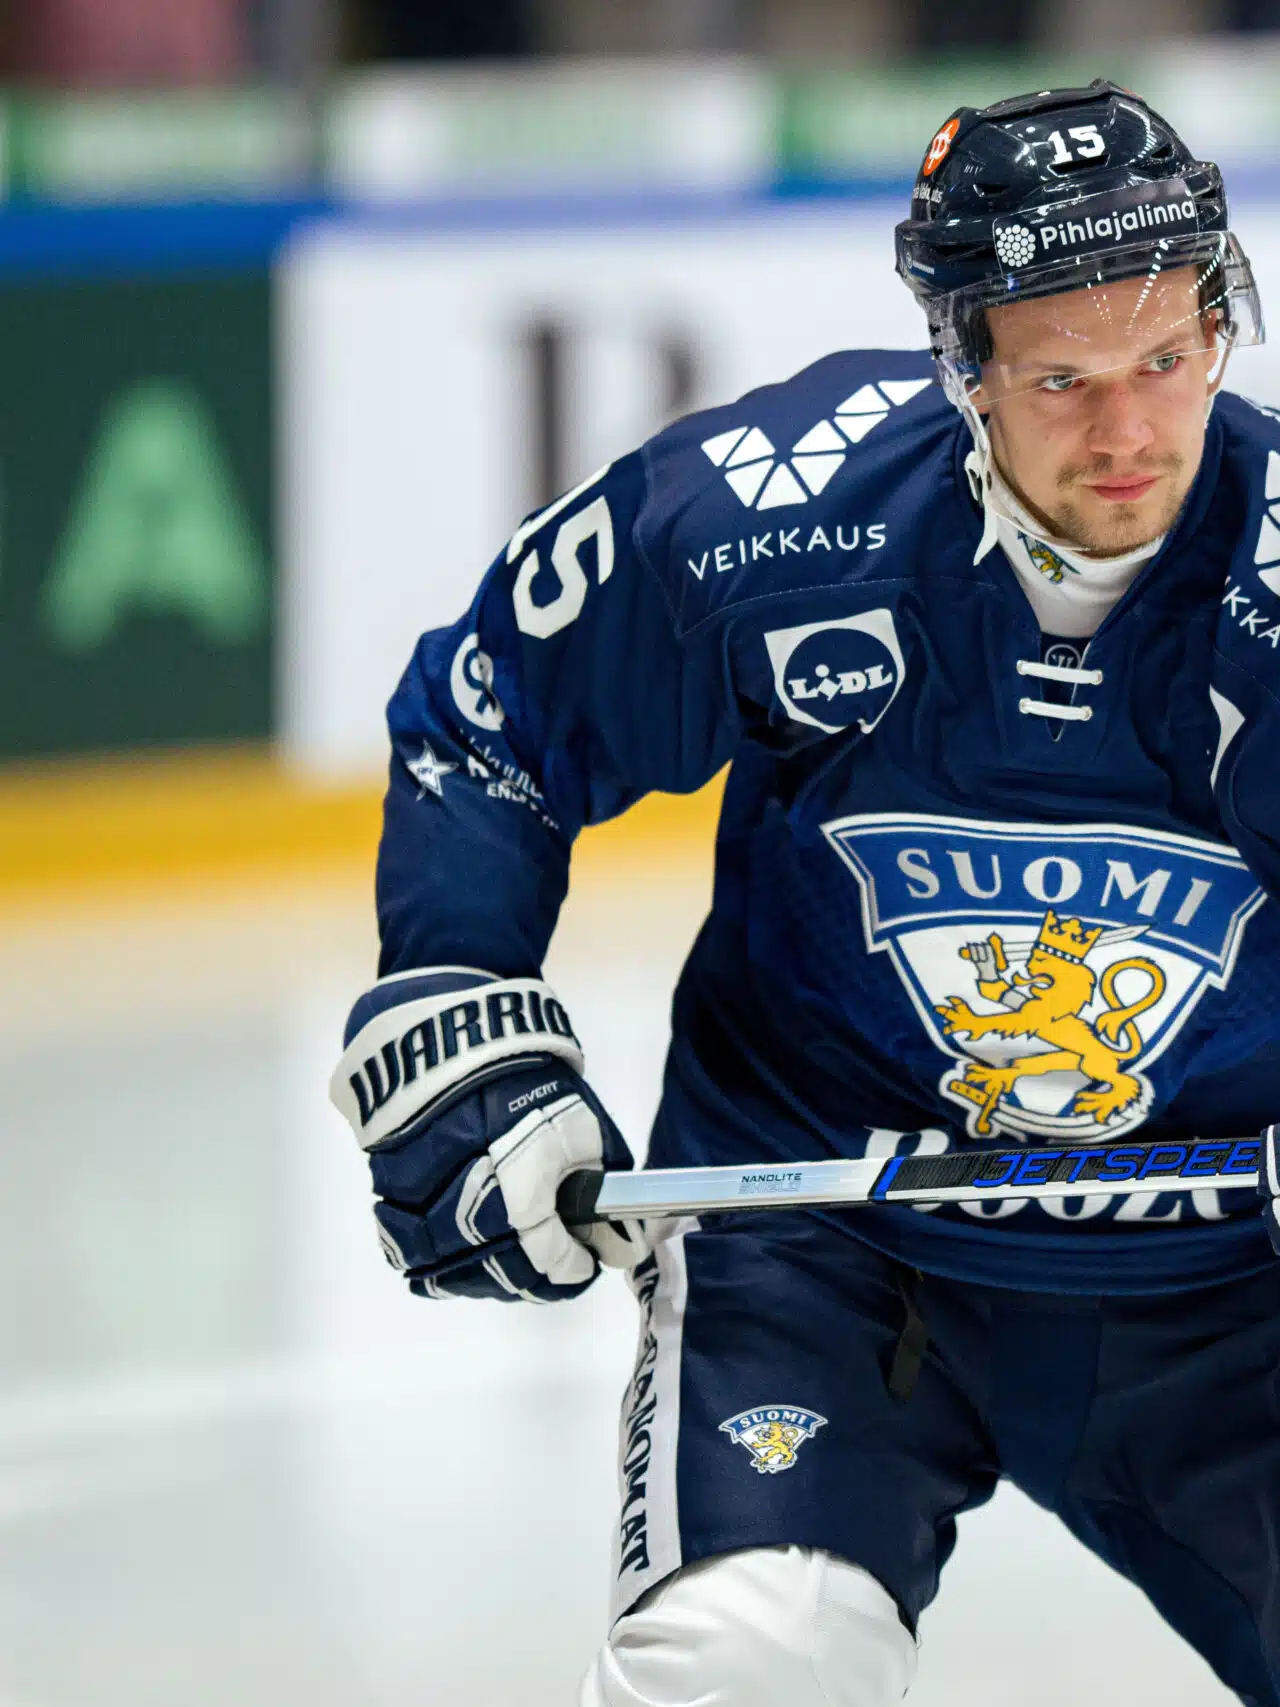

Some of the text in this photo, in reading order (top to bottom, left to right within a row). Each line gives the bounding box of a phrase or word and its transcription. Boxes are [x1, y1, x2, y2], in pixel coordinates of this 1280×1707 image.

[1046, 125, 1106, 165] 15
[1040, 199, 1196, 251] Pihlajalinna
[688, 523, 889, 580] VEIKKAUS
[896, 849, 1214, 927] SUOMI
[349, 991, 582, 1128] WARRIO
[508, 1080, 558, 1113] COVERT
[741, 1172, 803, 1183] NANOLITE
[973, 1141, 1260, 1188] JETSPEE
[739, 1410, 808, 1429] SUOMI
